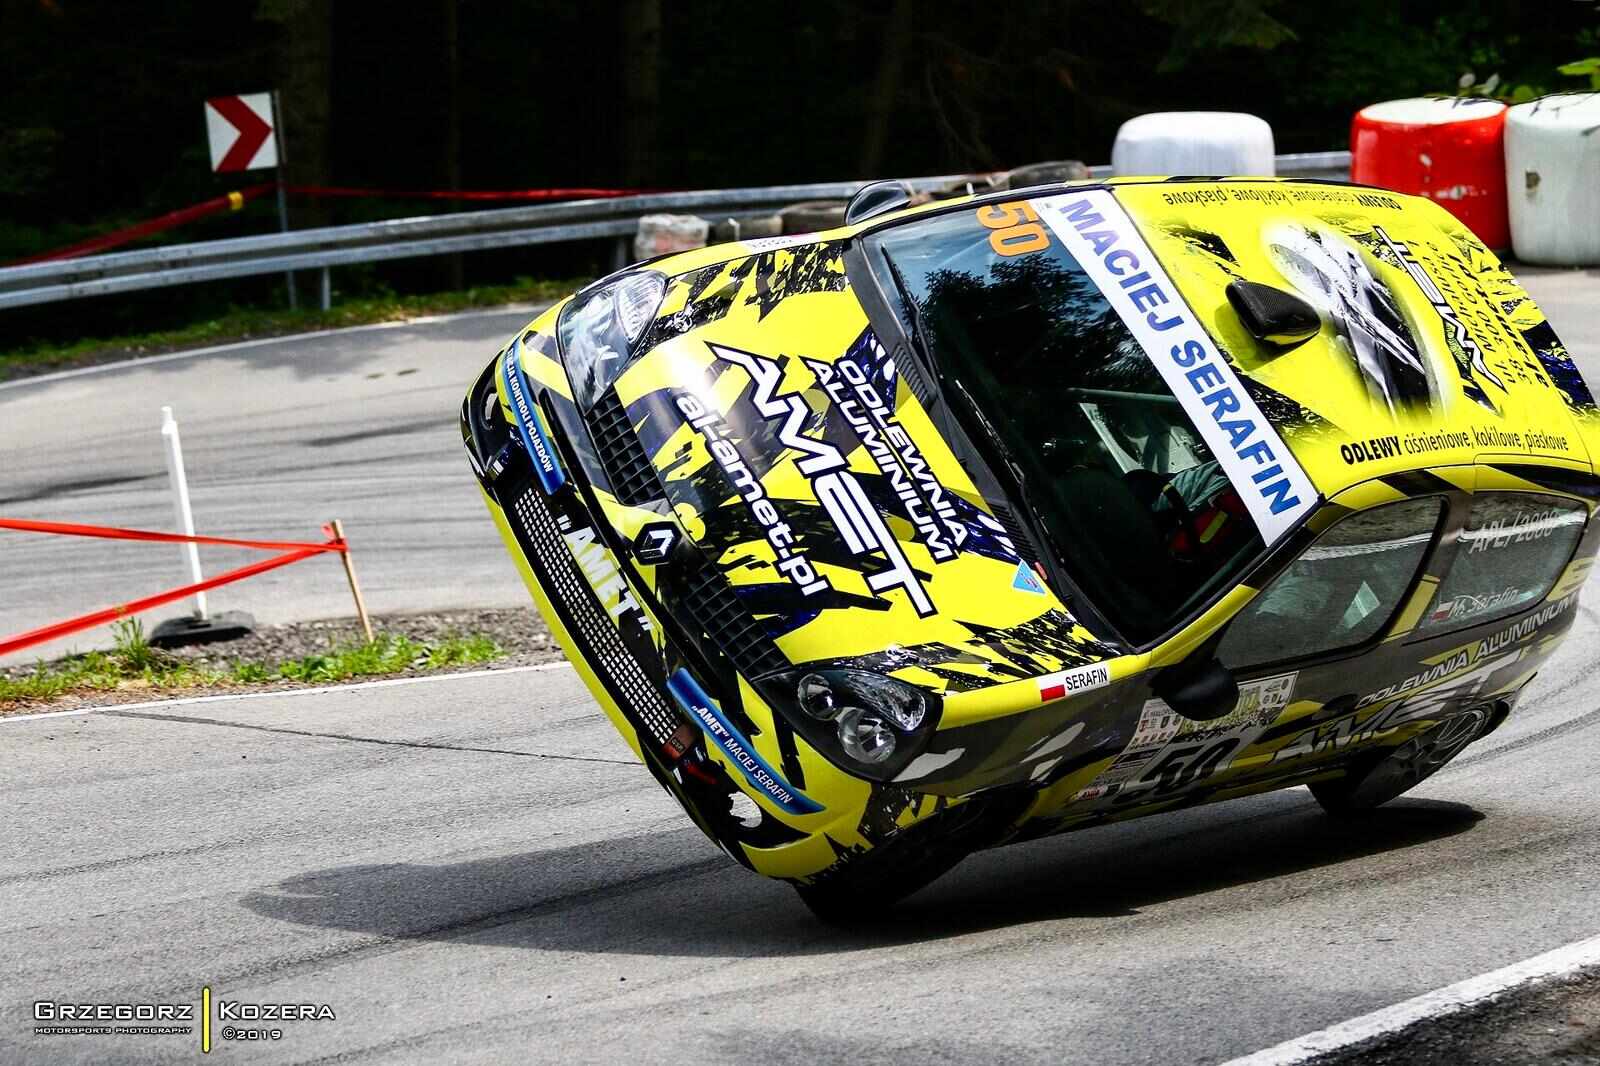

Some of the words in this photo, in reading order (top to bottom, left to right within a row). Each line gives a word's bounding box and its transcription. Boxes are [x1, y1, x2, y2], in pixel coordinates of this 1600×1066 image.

[975, 200, 1051, 258] 50
[1059, 198, 1185, 333] MACIEJ
[1169, 339, 1302, 516] SERAFIN
[509, 375, 532, 423] KONTROLI
[525, 422, 554, 473] POJAZDÓW
[803, 359, 955, 564] ALUMINIUM
[838, 359, 969, 547] ODLEWNIA
[1340, 435, 1403, 465] ODLEWY
[1523, 428, 1569, 454] piaskowe
[677, 394, 828, 597] al-amet.pl
[708, 343, 936, 616] AMET
[1065, 667, 1108, 691] SERAFIN
[1356, 651, 1469, 709] ODLEWNIA
[723, 737, 759, 773] MACIEJ
[753, 769, 794, 804] SERAFIN
